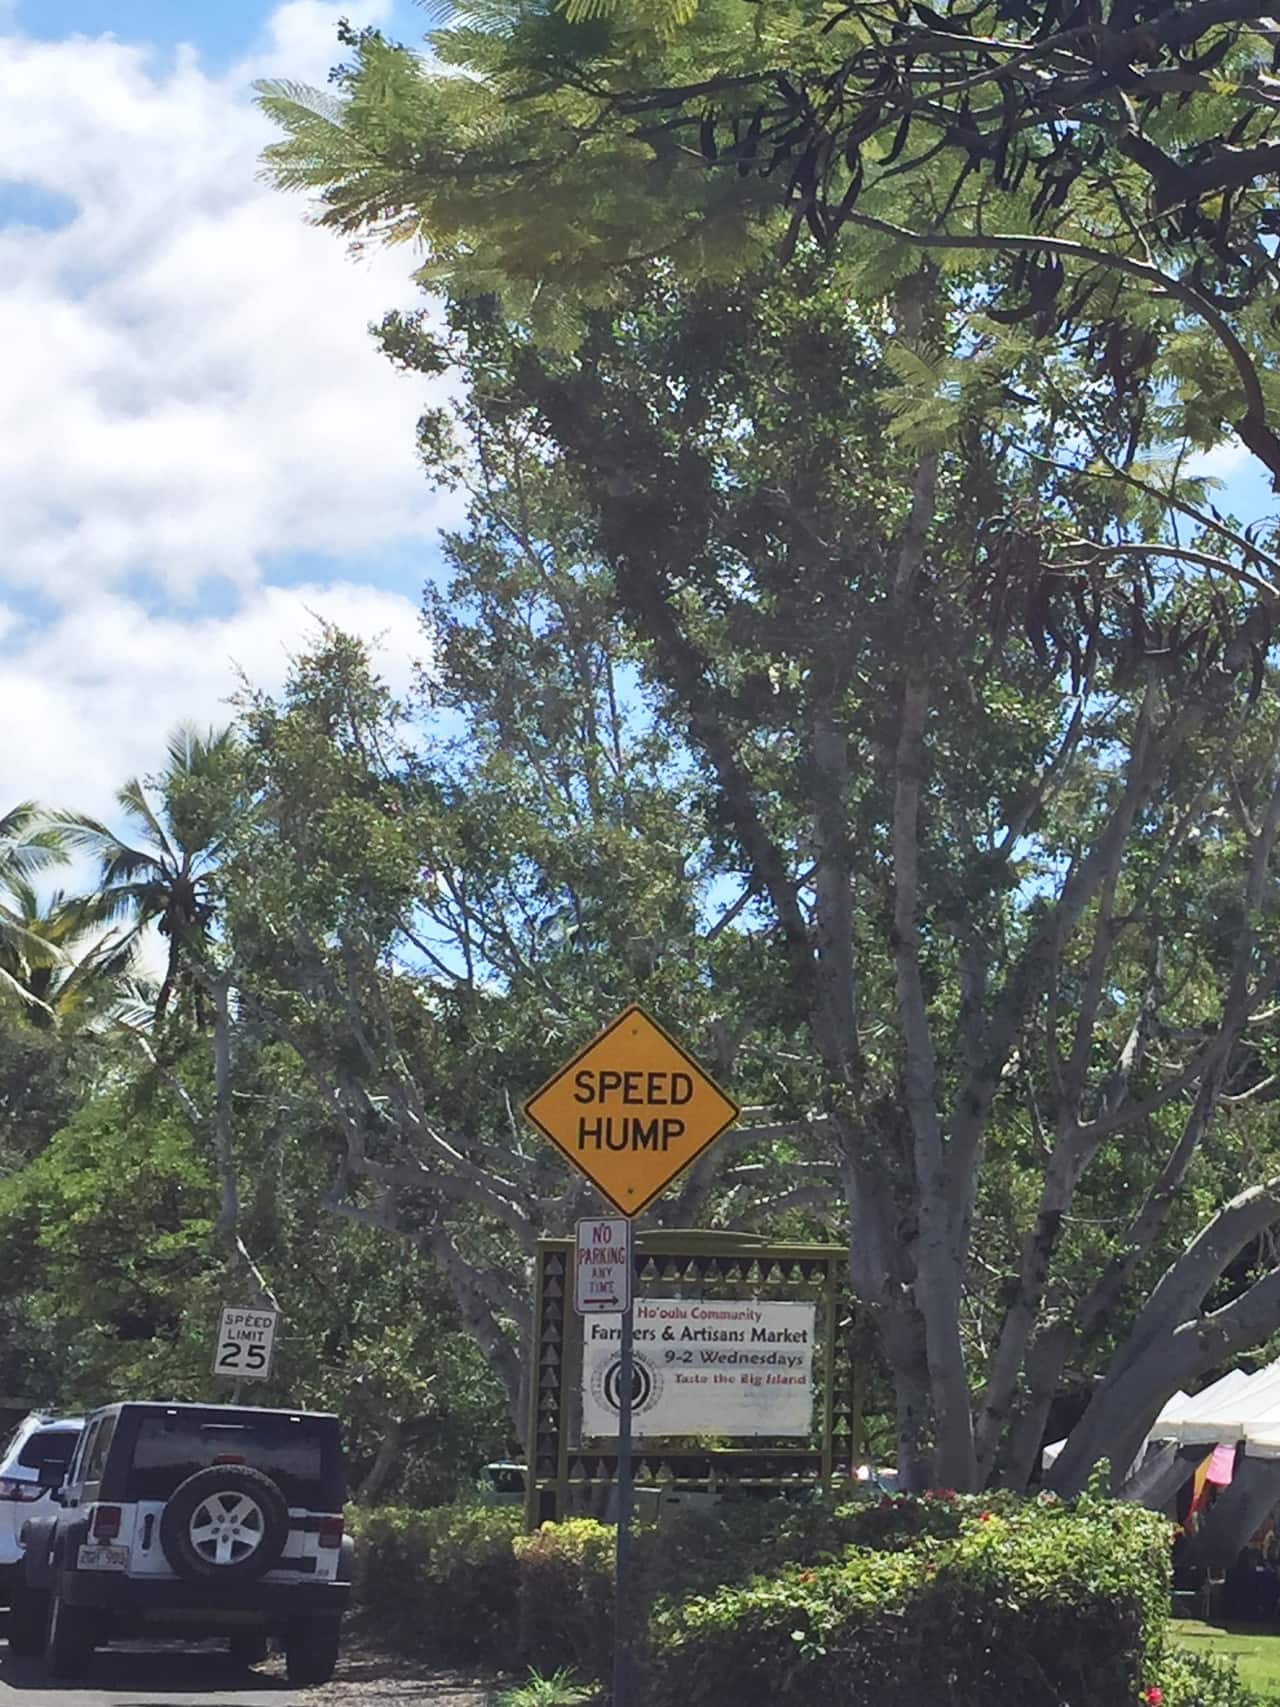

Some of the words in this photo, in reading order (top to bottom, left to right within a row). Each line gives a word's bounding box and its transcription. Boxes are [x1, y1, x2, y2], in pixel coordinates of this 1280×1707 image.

[573, 1070, 694, 1105] SPEED
[578, 1117, 685, 1151] HUMP
[592, 1225, 613, 1244] NO
[577, 1247, 626, 1265] PARKING
[592, 1266, 613, 1280] ANY
[589, 1281, 615, 1294] TIME
[225, 1313, 273, 1329] SPEED
[691, 1307, 762, 1323] Community
[227, 1328, 265, 1342] LIMIT
[591, 1324, 656, 1341] Farers
[661, 1325, 675, 1342] &
[680, 1326, 745, 1342] Artisans
[751, 1328, 808, 1343] Market
[219, 1341, 266, 1370] 25
[664, 1350, 694, 1363] 9-2
[699, 1351, 803, 1368] Wednesdays
[674, 1374, 708, 1385] Taste
[713, 1374, 736, 1385] the
